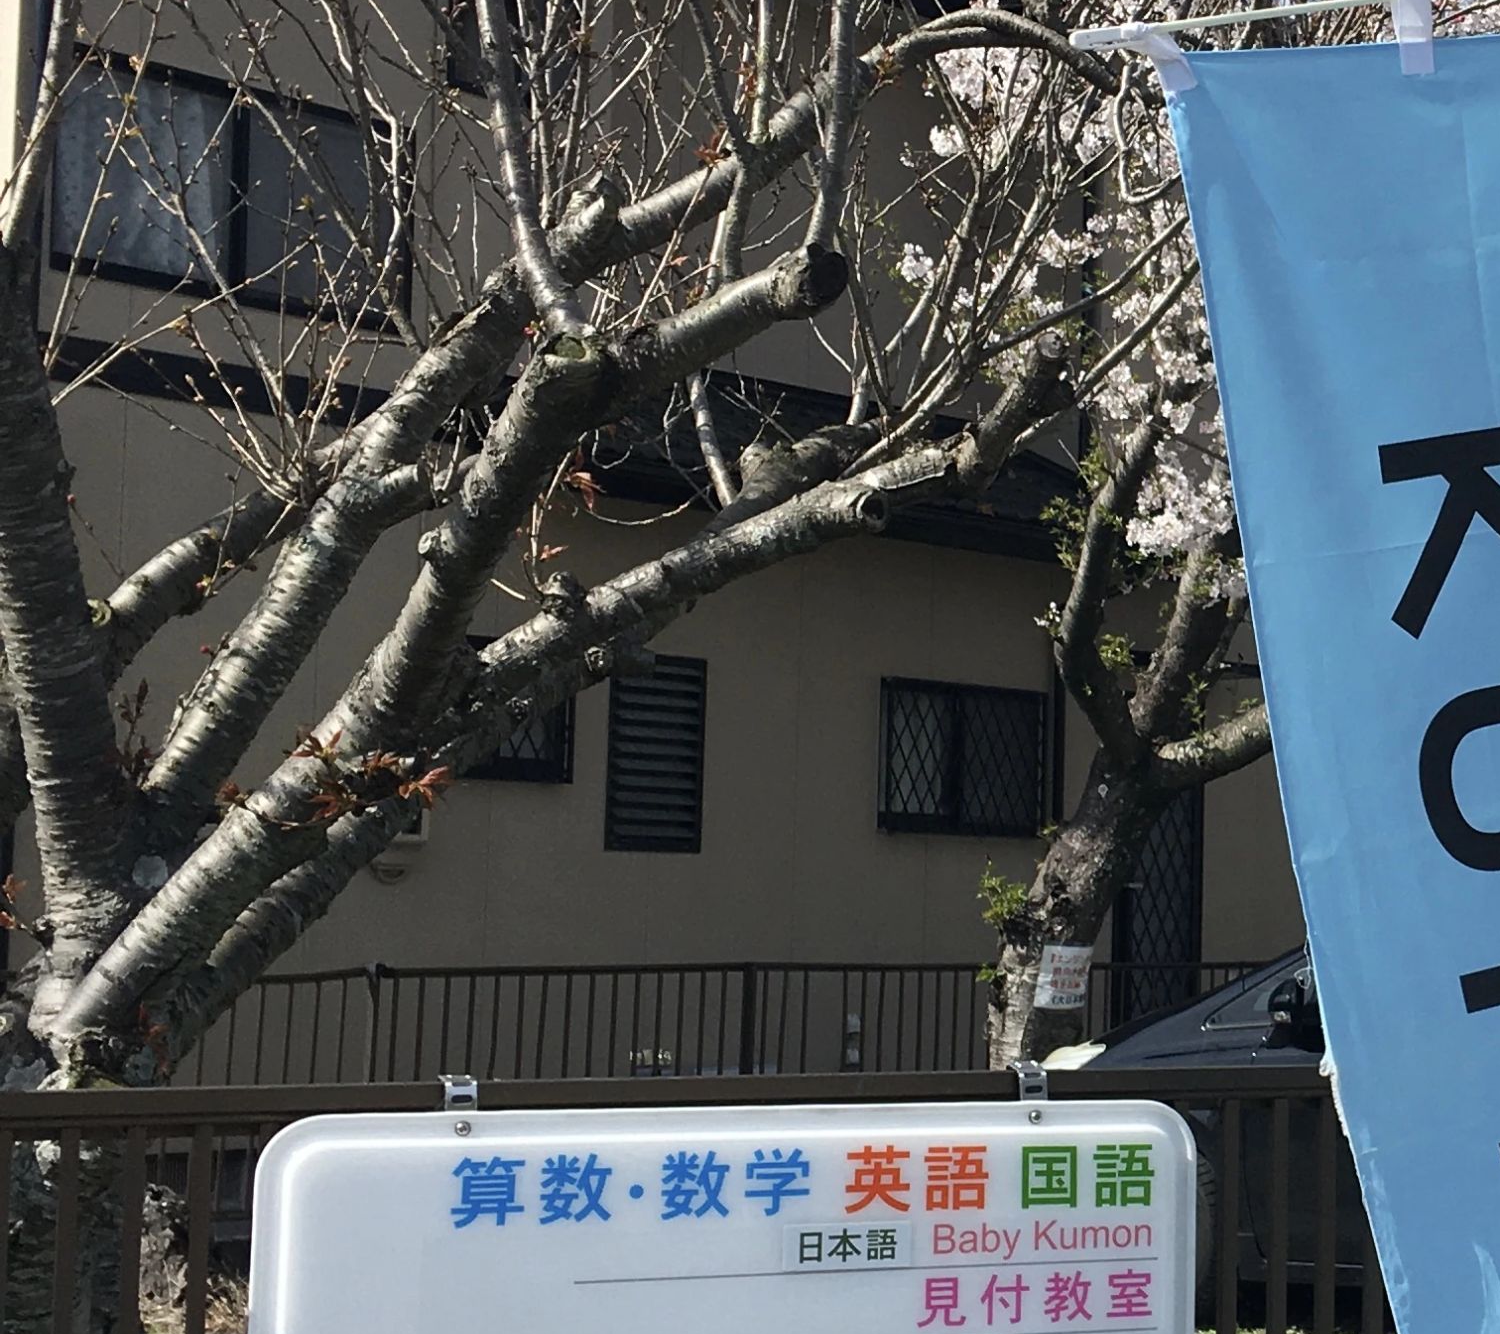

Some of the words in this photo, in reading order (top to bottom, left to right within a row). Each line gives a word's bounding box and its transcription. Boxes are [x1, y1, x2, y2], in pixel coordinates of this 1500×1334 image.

[450, 1148, 811, 1229] 算数・数学
[844, 1145, 989, 1214] 英語
[1021, 1144, 1155, 1209] 国語
[798, 1227, 898, 1265] 日本語
[932, 1222, 1022, 1261] Baby
[1033, 1219, 1153, 1252] Kumon
[916, 1268, 1153, 1329] 見付教室
